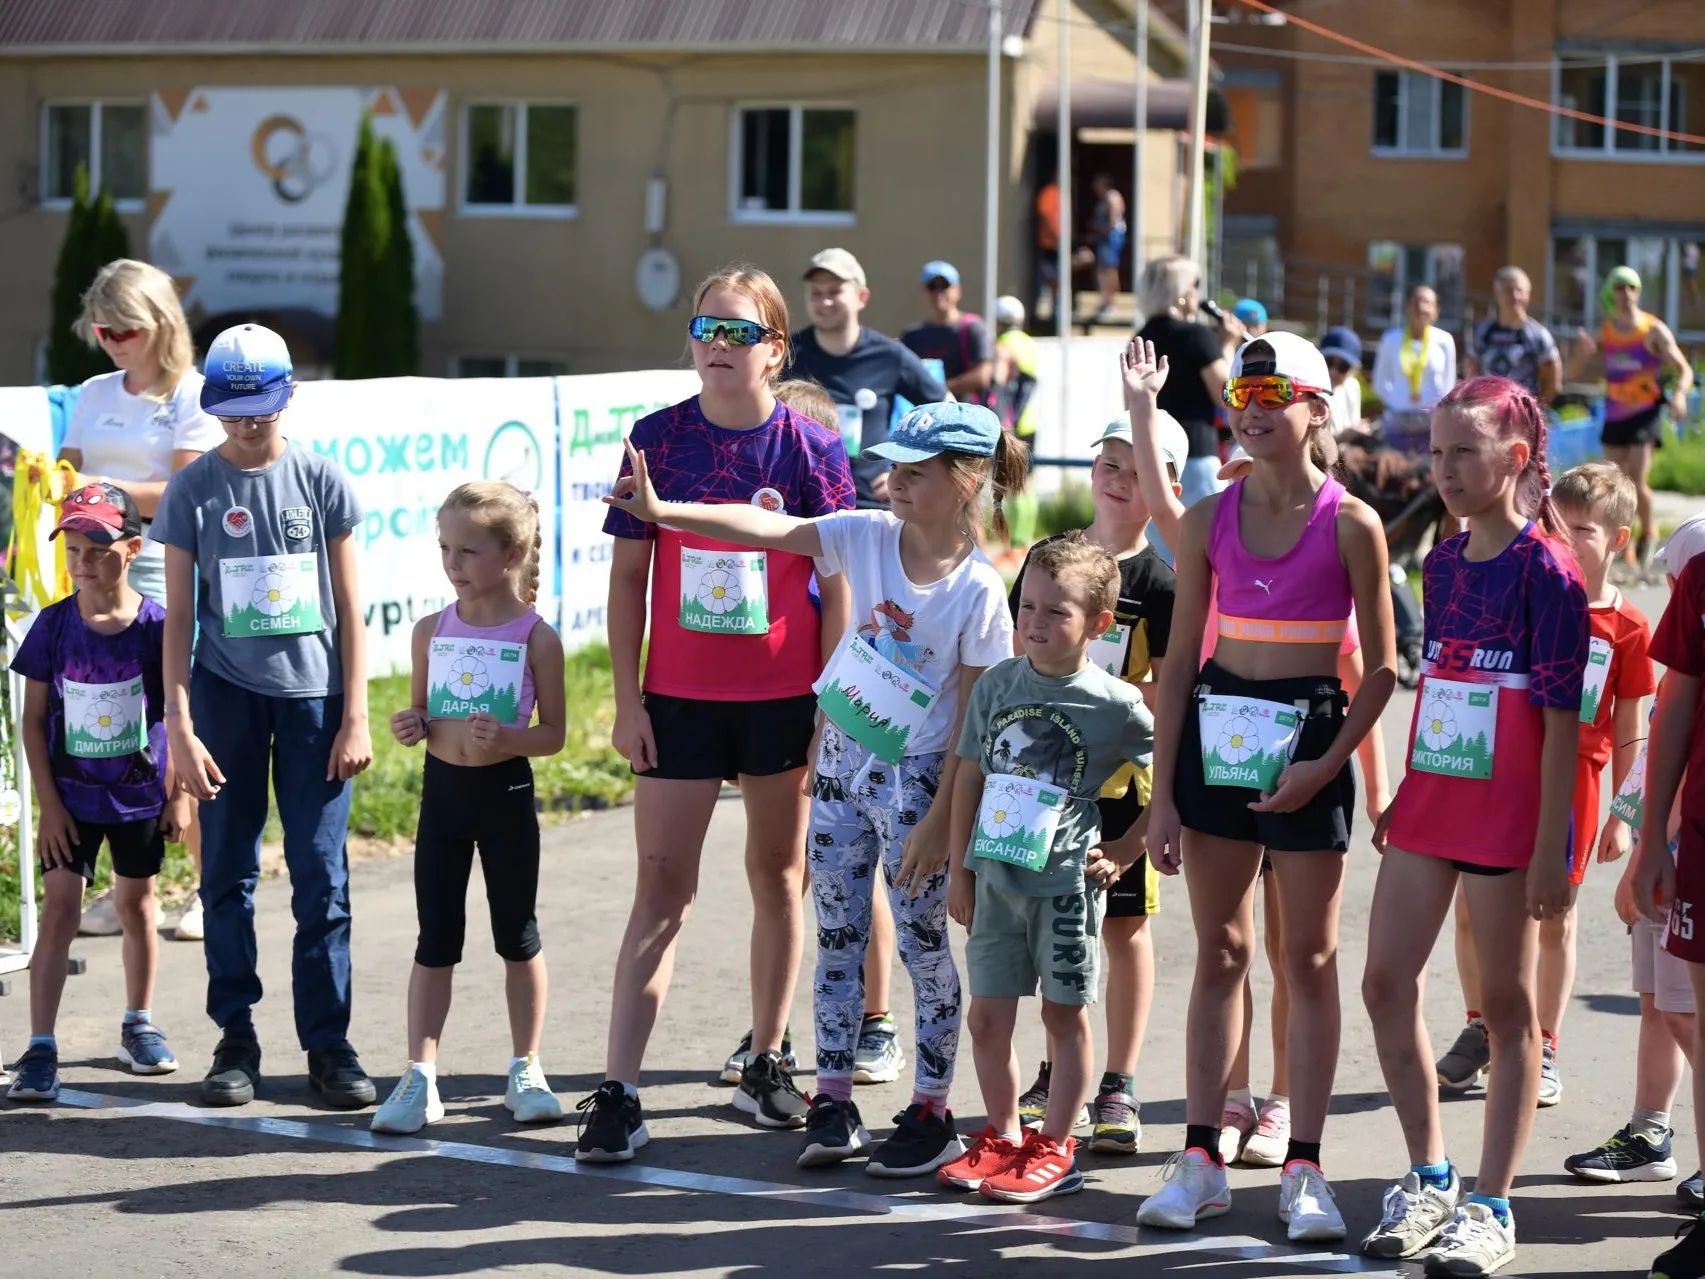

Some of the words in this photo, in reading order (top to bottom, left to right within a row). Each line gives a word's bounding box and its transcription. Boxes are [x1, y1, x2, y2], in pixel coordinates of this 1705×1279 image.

[223, 360, 266, 373] CREATE
[244, 374, 262, 382] OWN
[249, 613, 302, 631] СЕМЁН
[685, 612, 756, 631] НАДЕЖДА
[441, 700, 490, 714] ДАРЬЯ
[74, 735, 138, 754] ДМИТРИЙ
[996, 708, 1042, 730] PARADISE
[1049, 712, 1080, 744] ISLAND
[1069, 750, 1085, 793] SUNSET
[1208, 765, 1259, 782] УЛЬЯНА
[1671, 900, 1694, 940] 65
[1051, 894, 1087, 991] SURF
